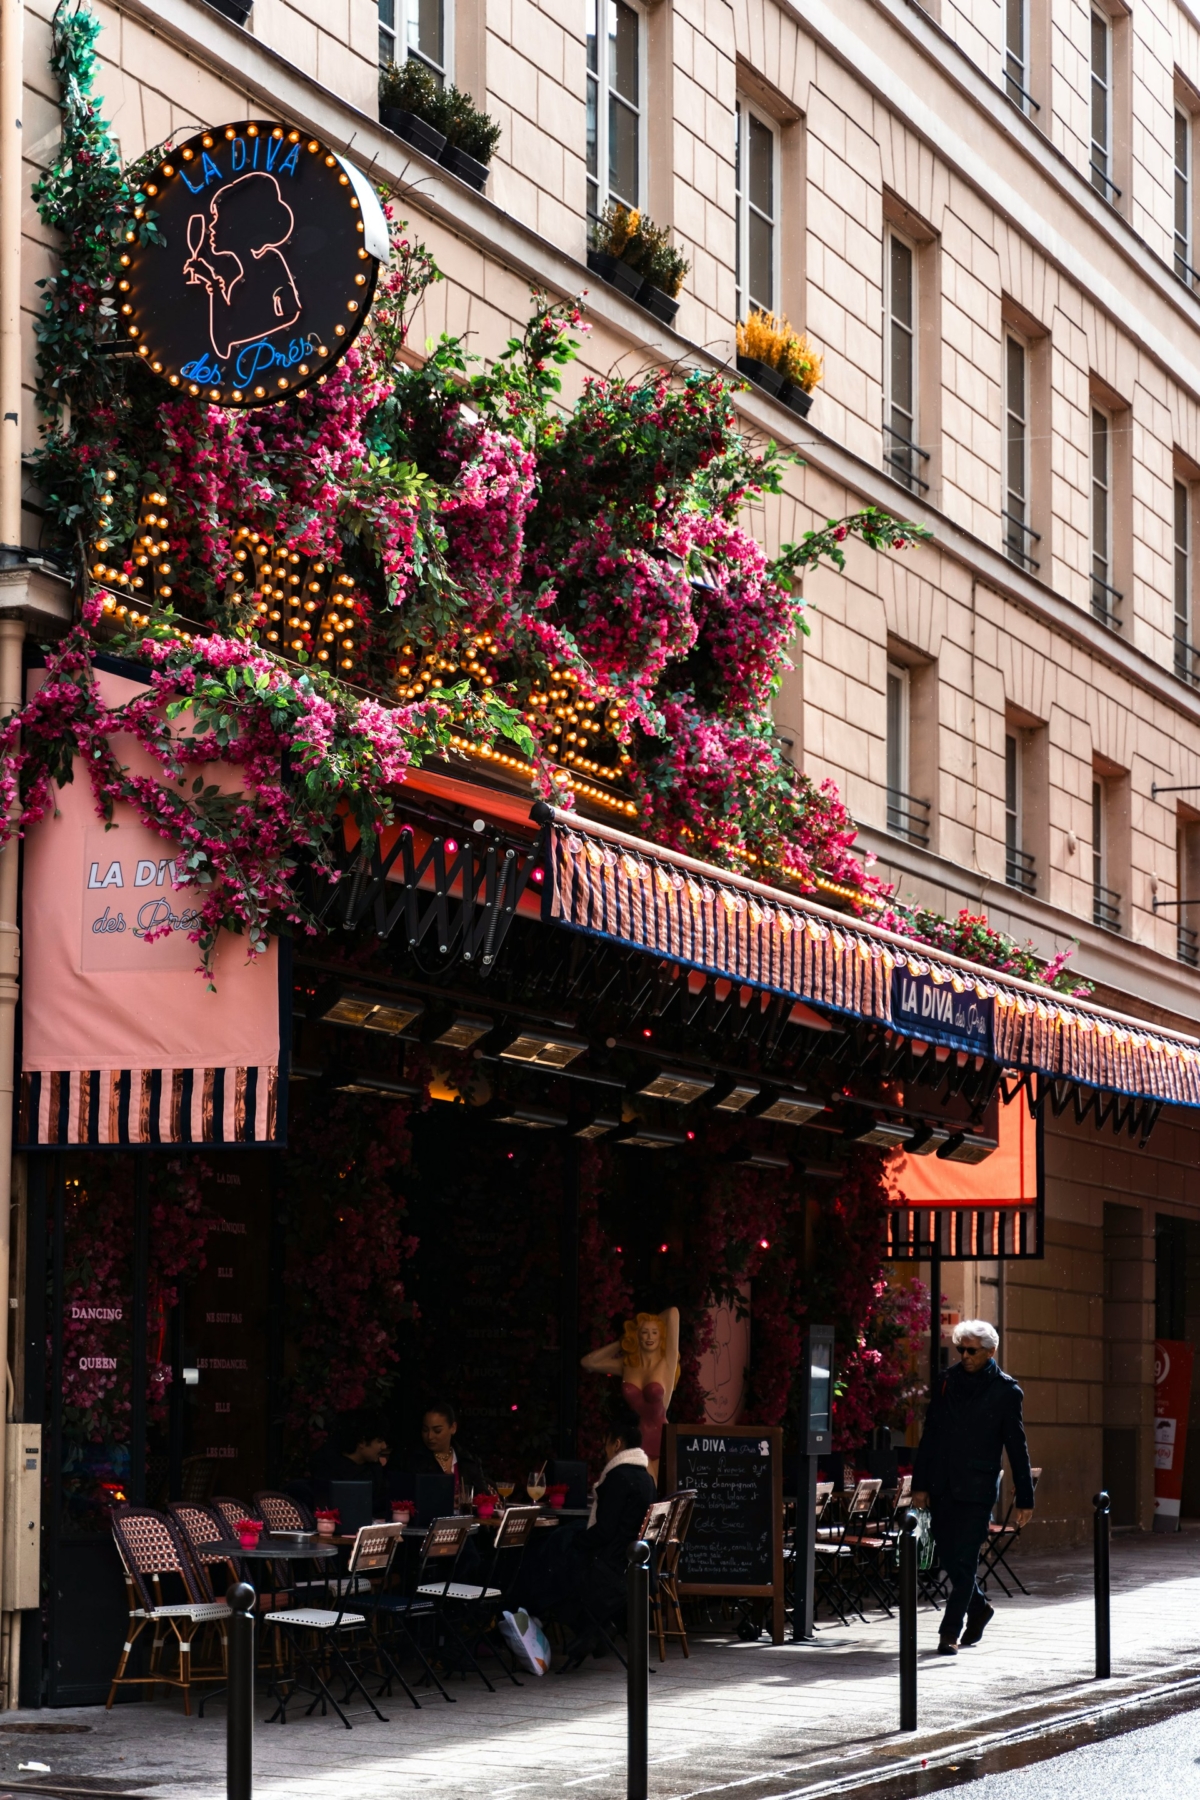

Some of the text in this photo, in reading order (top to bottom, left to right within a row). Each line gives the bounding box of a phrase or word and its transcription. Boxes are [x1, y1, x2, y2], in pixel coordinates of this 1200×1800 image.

[179, 136, 301, 194] LA DIVA
[181, 337, 314, 388] des Prés
[87, 862, 124, 889] LA
[92, 897, 200, 938] des Prés
[902, 978, 918, 1014] LA
[922, 984, 954, 1024] DIVA
[955, 1004, 966, 1028] des
[216, 1173, 241, 1186] LA DIVA
[218, 1267, 234, 1278] ELLE
[71, 1308, 122, 1320] DANCING
[206, 1312, 242, 1324] NE SUIT PAS
[78, 1357, 118, 1370] QUEEN
[196, 1358, 208, 1368] LES
[215, 1402, 230, 1412] ELLE
[702, 1439, 726, 1452] DIVA
[206, 1447, 218, 1458] LES
[688, 1457, 711, 1473] Vous
[712, 1478, 758, 1492] champignons
